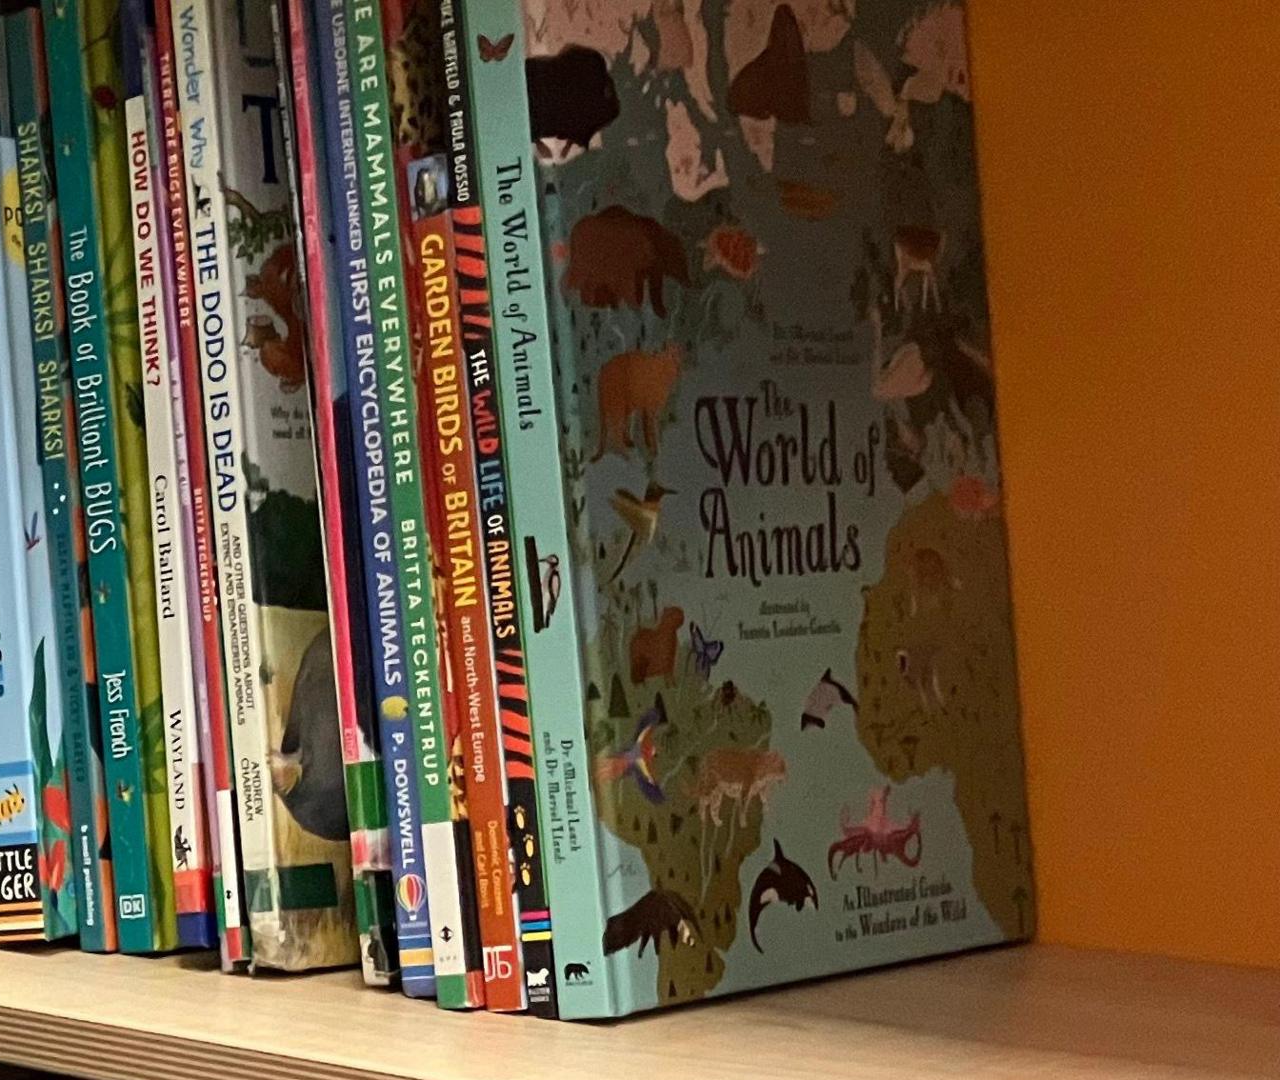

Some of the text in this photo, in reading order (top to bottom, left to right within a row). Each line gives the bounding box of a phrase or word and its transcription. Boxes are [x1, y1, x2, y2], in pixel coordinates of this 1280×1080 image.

[330, 13, 350, 95] USBORNE
[355, 34, 378, 92] ARE
[337, 98, 363, 252] INTERNET-LINKED
[361, 102, 393, 265] MAMMALS
[130, 130, 161, 387] HOW DO WE THINK?
[178, 5, 238, 513] Wonder Why THE DODO IS DEAD
[348, 258, 371, 324] FIRST
[494, 156, 545, 431] The World of Animals
[67, 224, 116, 554] The Book of Brilliant BUGS
[354, 333, 389, 524] ENCYCLOPEDIA
[377, 275, 413, 485] EVERYWHERE
[694, 396, 881, 496] World of
[152, 474, 175, 619] Carol Ballard
[372, 531, 391, 563] OF
[418, 233, 488, 783] GARDEN BIRDS OF BRITAIN and North-West Europe
[698, 487, 862, 587] Animals
[374, 571, 402, 685] ANIMALS
[400, 518, 438, 786] BRITTA TECKENTRUP
[102, 670, 131, 758] Jess French
[391, 732, 414, 868] P. DOWSWELL
